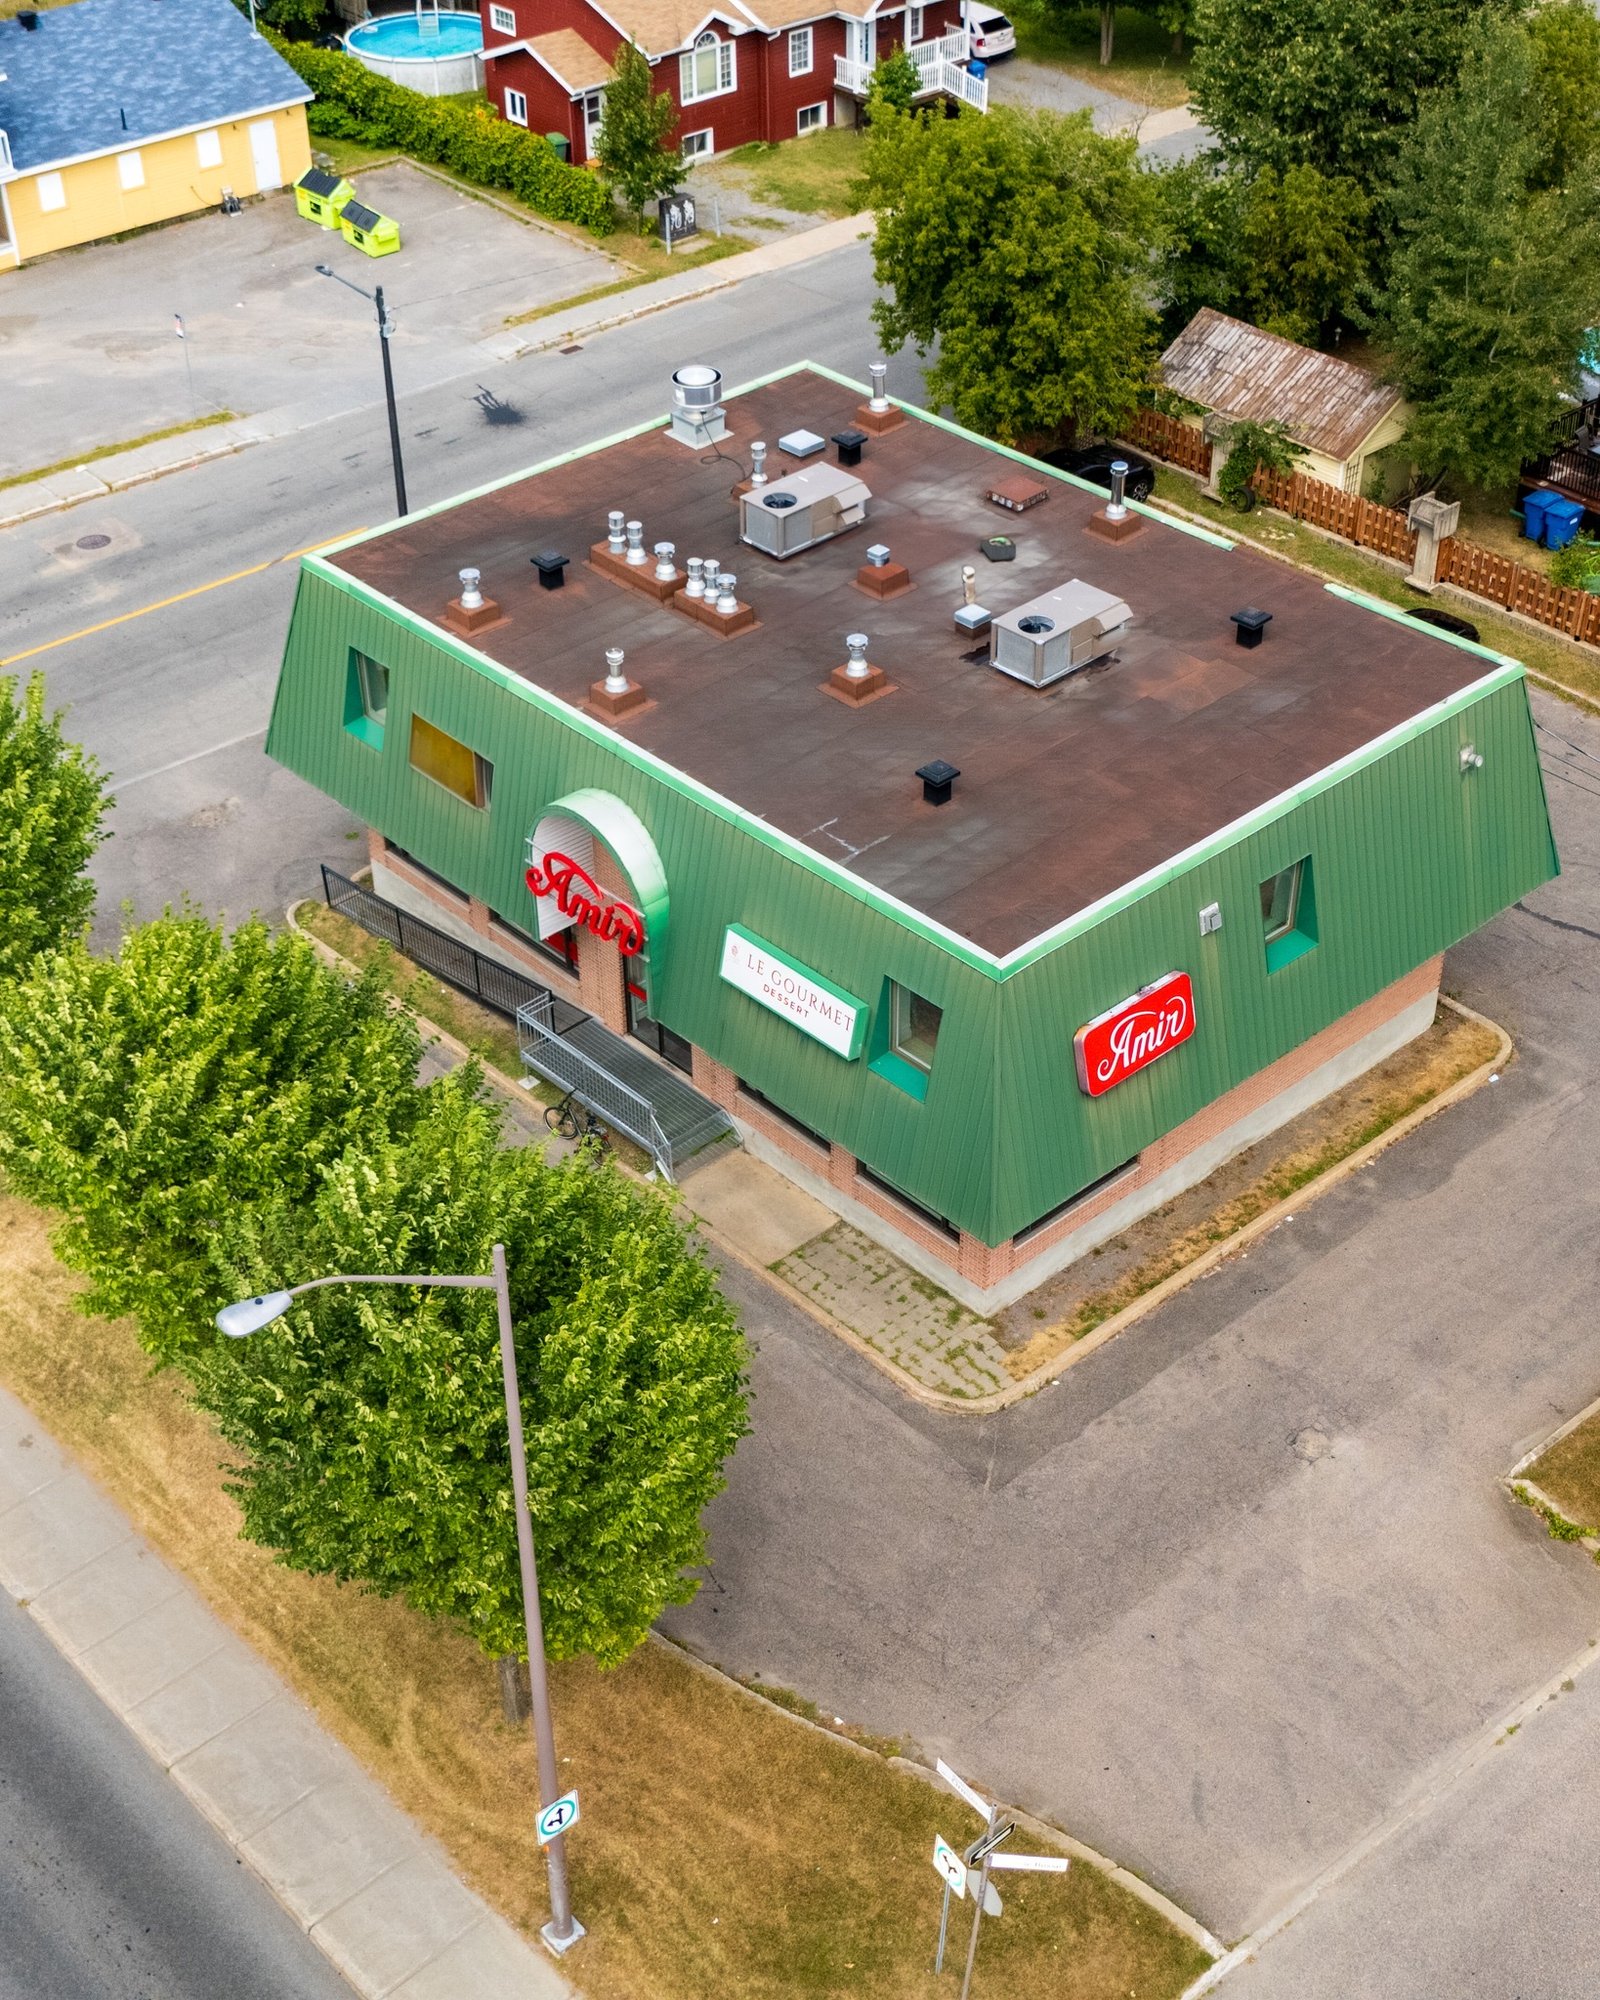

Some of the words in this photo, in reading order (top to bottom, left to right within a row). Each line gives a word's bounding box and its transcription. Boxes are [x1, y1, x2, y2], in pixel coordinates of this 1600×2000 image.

[525, 852, 643, 956] Amir
[747, 954, 765, 976] LE
[771, 969, 854, 1032] GOURMET
[763, 983, 810, 1019] DESSERT
[1097, 995, 1187, 1082] Amir
